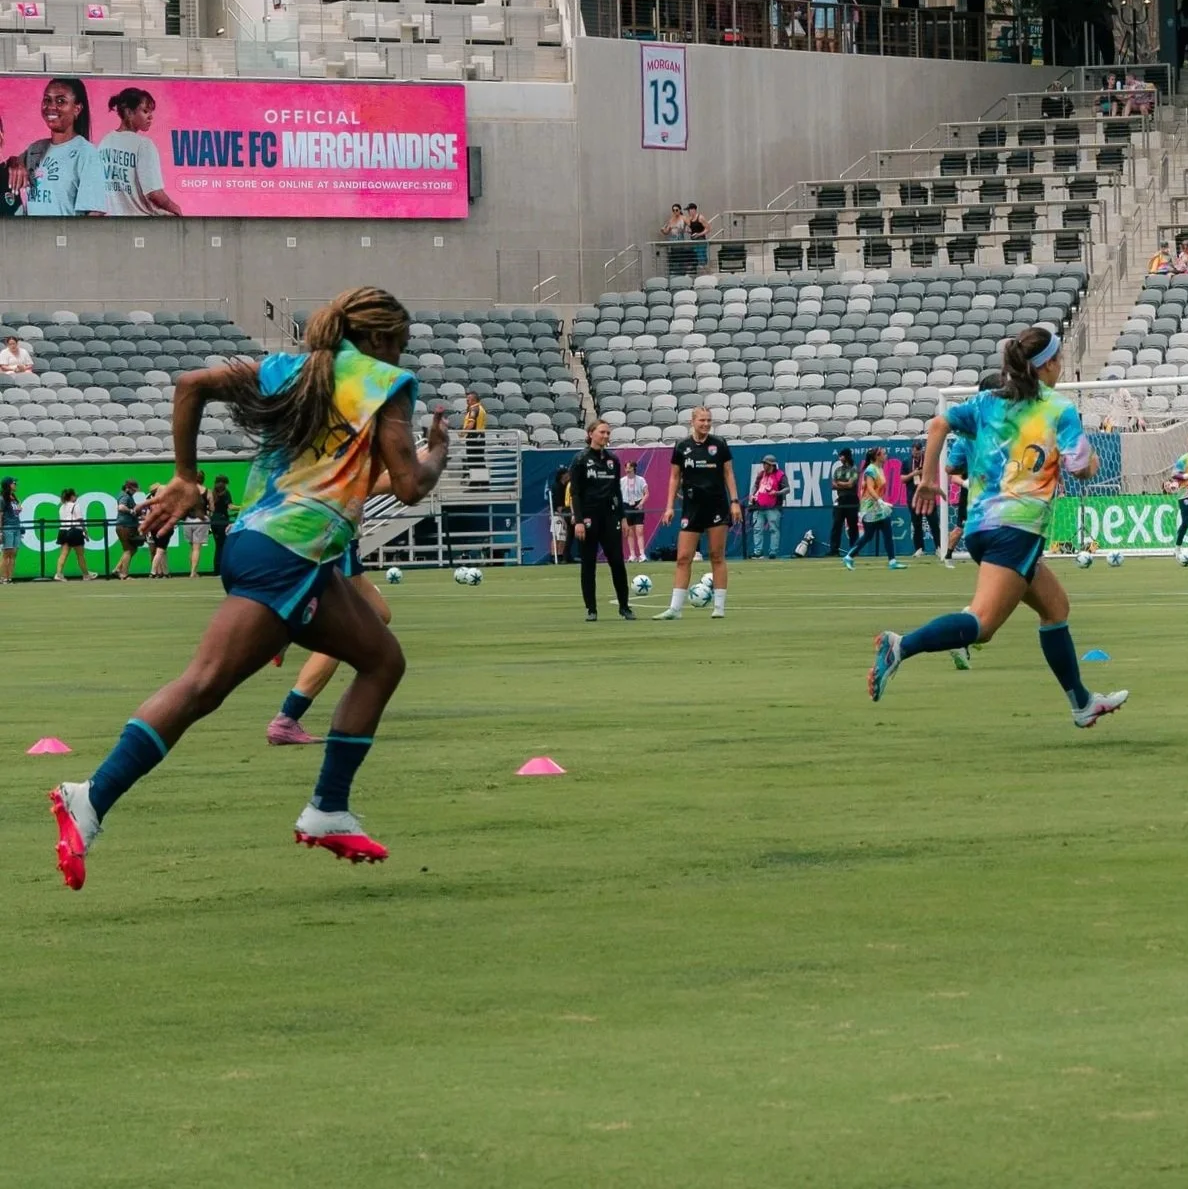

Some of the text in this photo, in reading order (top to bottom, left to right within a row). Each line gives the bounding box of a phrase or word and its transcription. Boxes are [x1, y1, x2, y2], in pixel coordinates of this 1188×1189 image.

[647, 59, 680, 72] MORGAN
[650, 79, 679, 125] 13
[264, 109, 360, 125] OFFICIAL
[171, 130, 457, 170] WAVE FC MERCHANDISE
[181, 179, 453, 190] SHOP IN STORE OR ONLINE AT SANDIEGOWAVEFC.STORE
